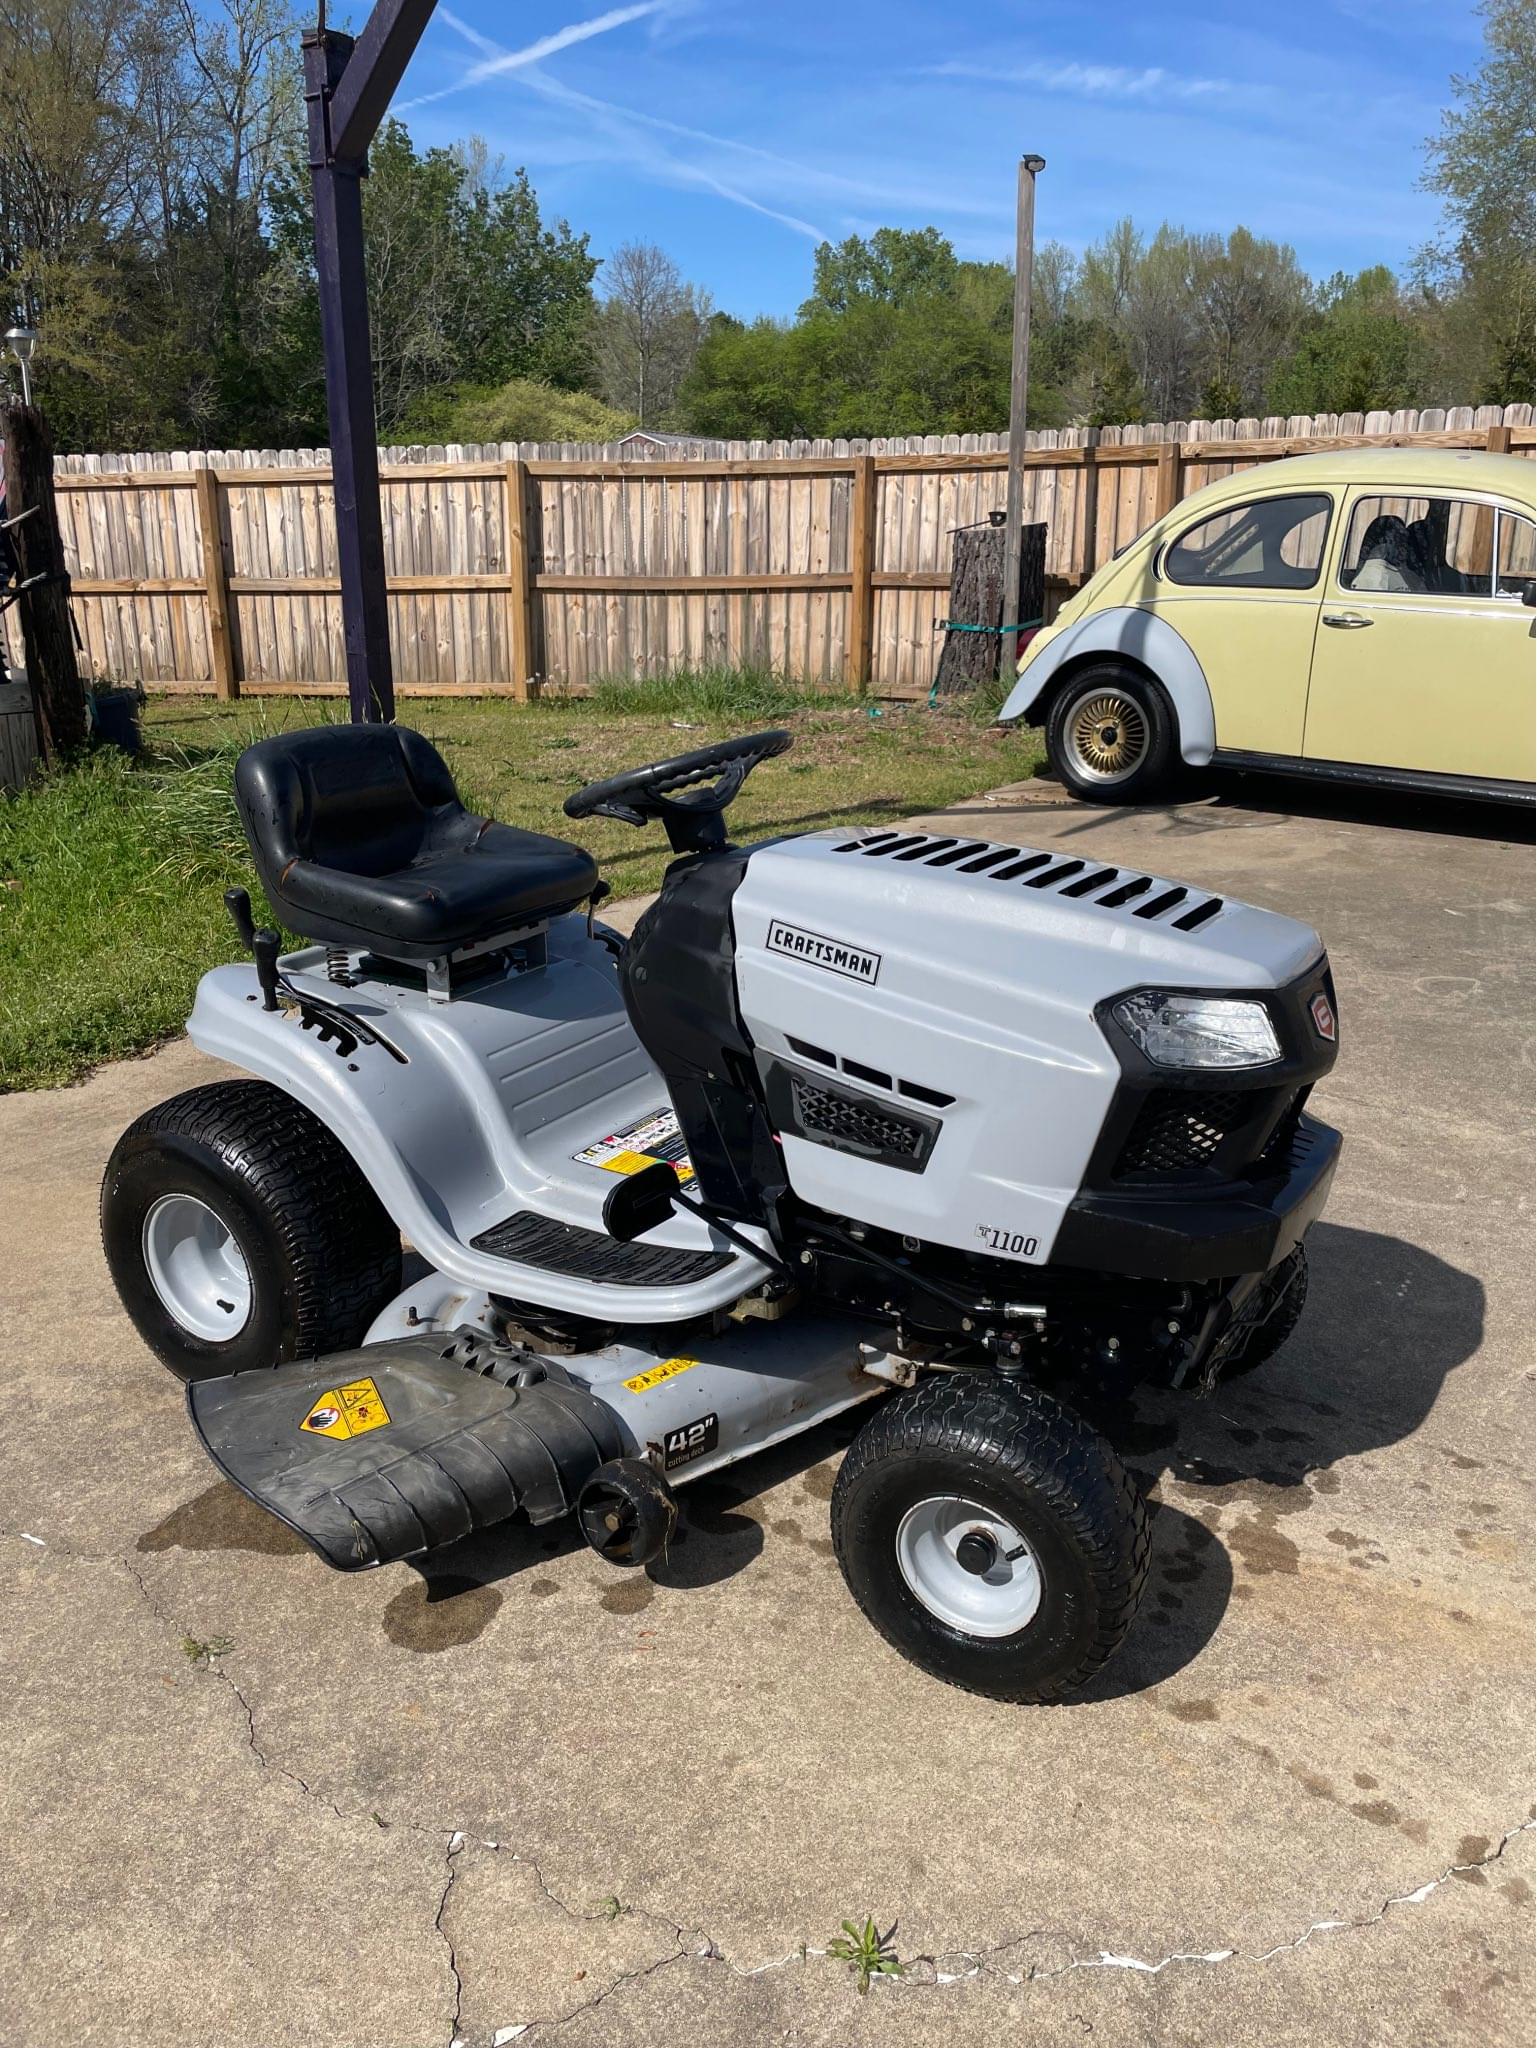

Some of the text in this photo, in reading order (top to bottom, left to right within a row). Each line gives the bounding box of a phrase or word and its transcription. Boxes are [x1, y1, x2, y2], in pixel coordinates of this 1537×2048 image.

[774, 928, 873, 976] CRAFTSMAN
[979, 1226, 1038, 1256] T1100
[669, 1416, 714, 1452] 42"
[668, 1446, 705, 1468] cutting deck
